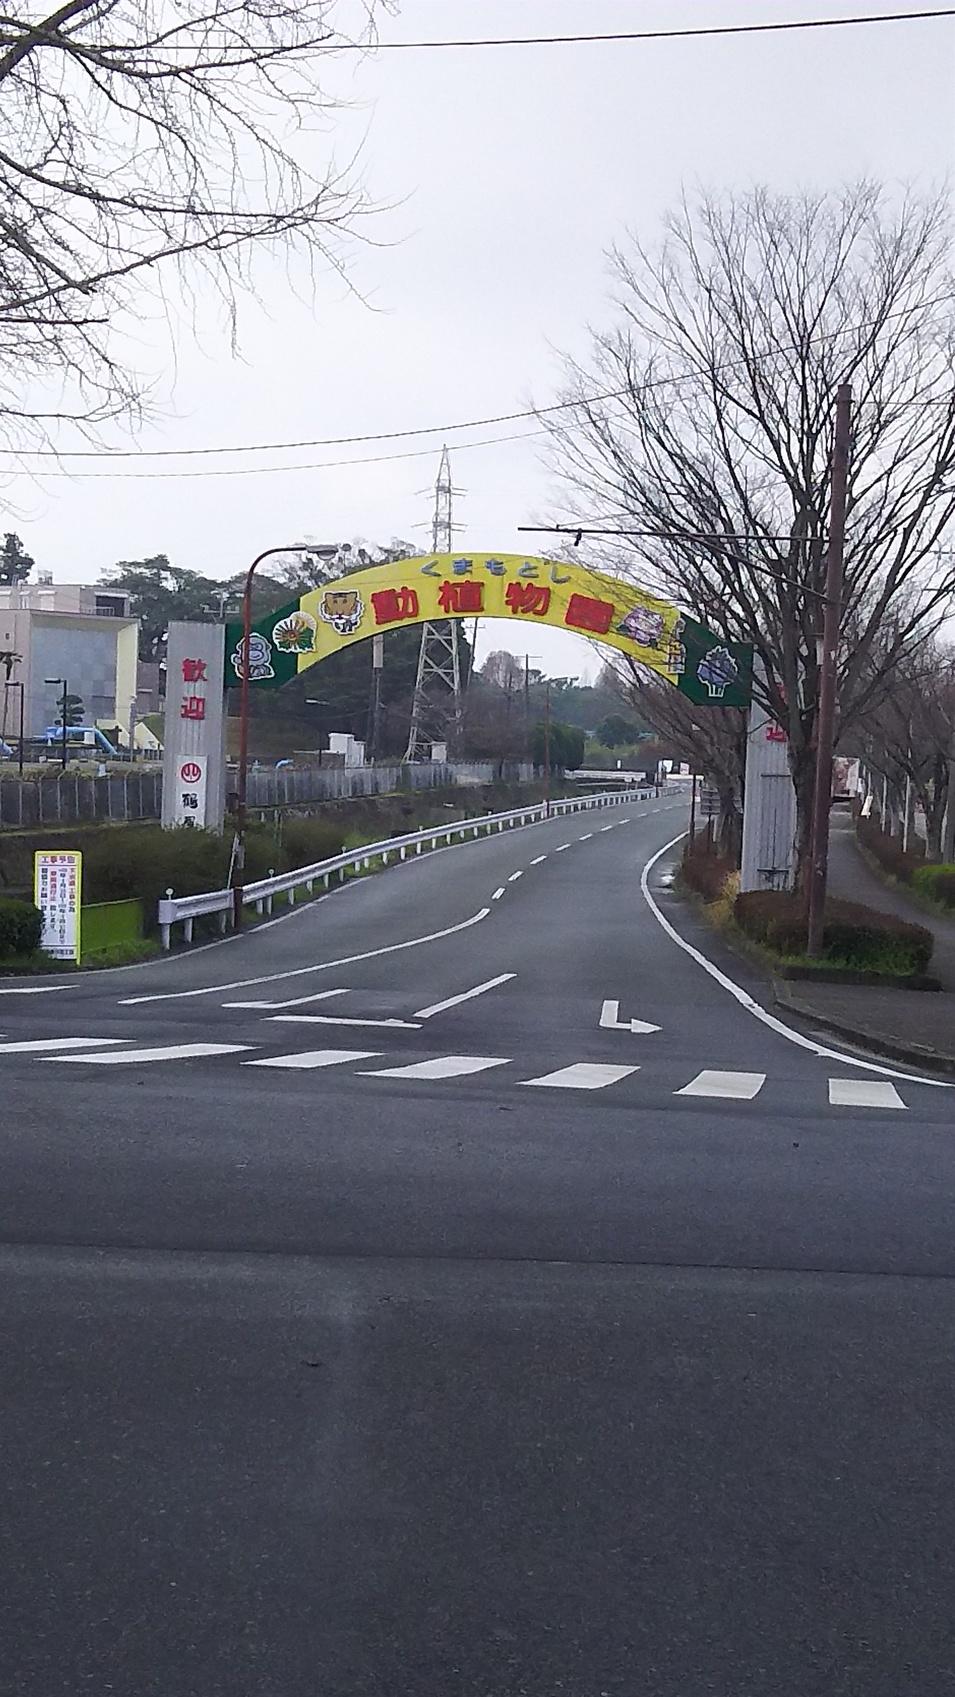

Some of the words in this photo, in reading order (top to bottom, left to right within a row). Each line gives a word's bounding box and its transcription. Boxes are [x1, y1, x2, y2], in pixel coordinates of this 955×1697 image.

[421, 558, 571, 584] くまもとし
[181, 658, 208, 721] 歓迎
